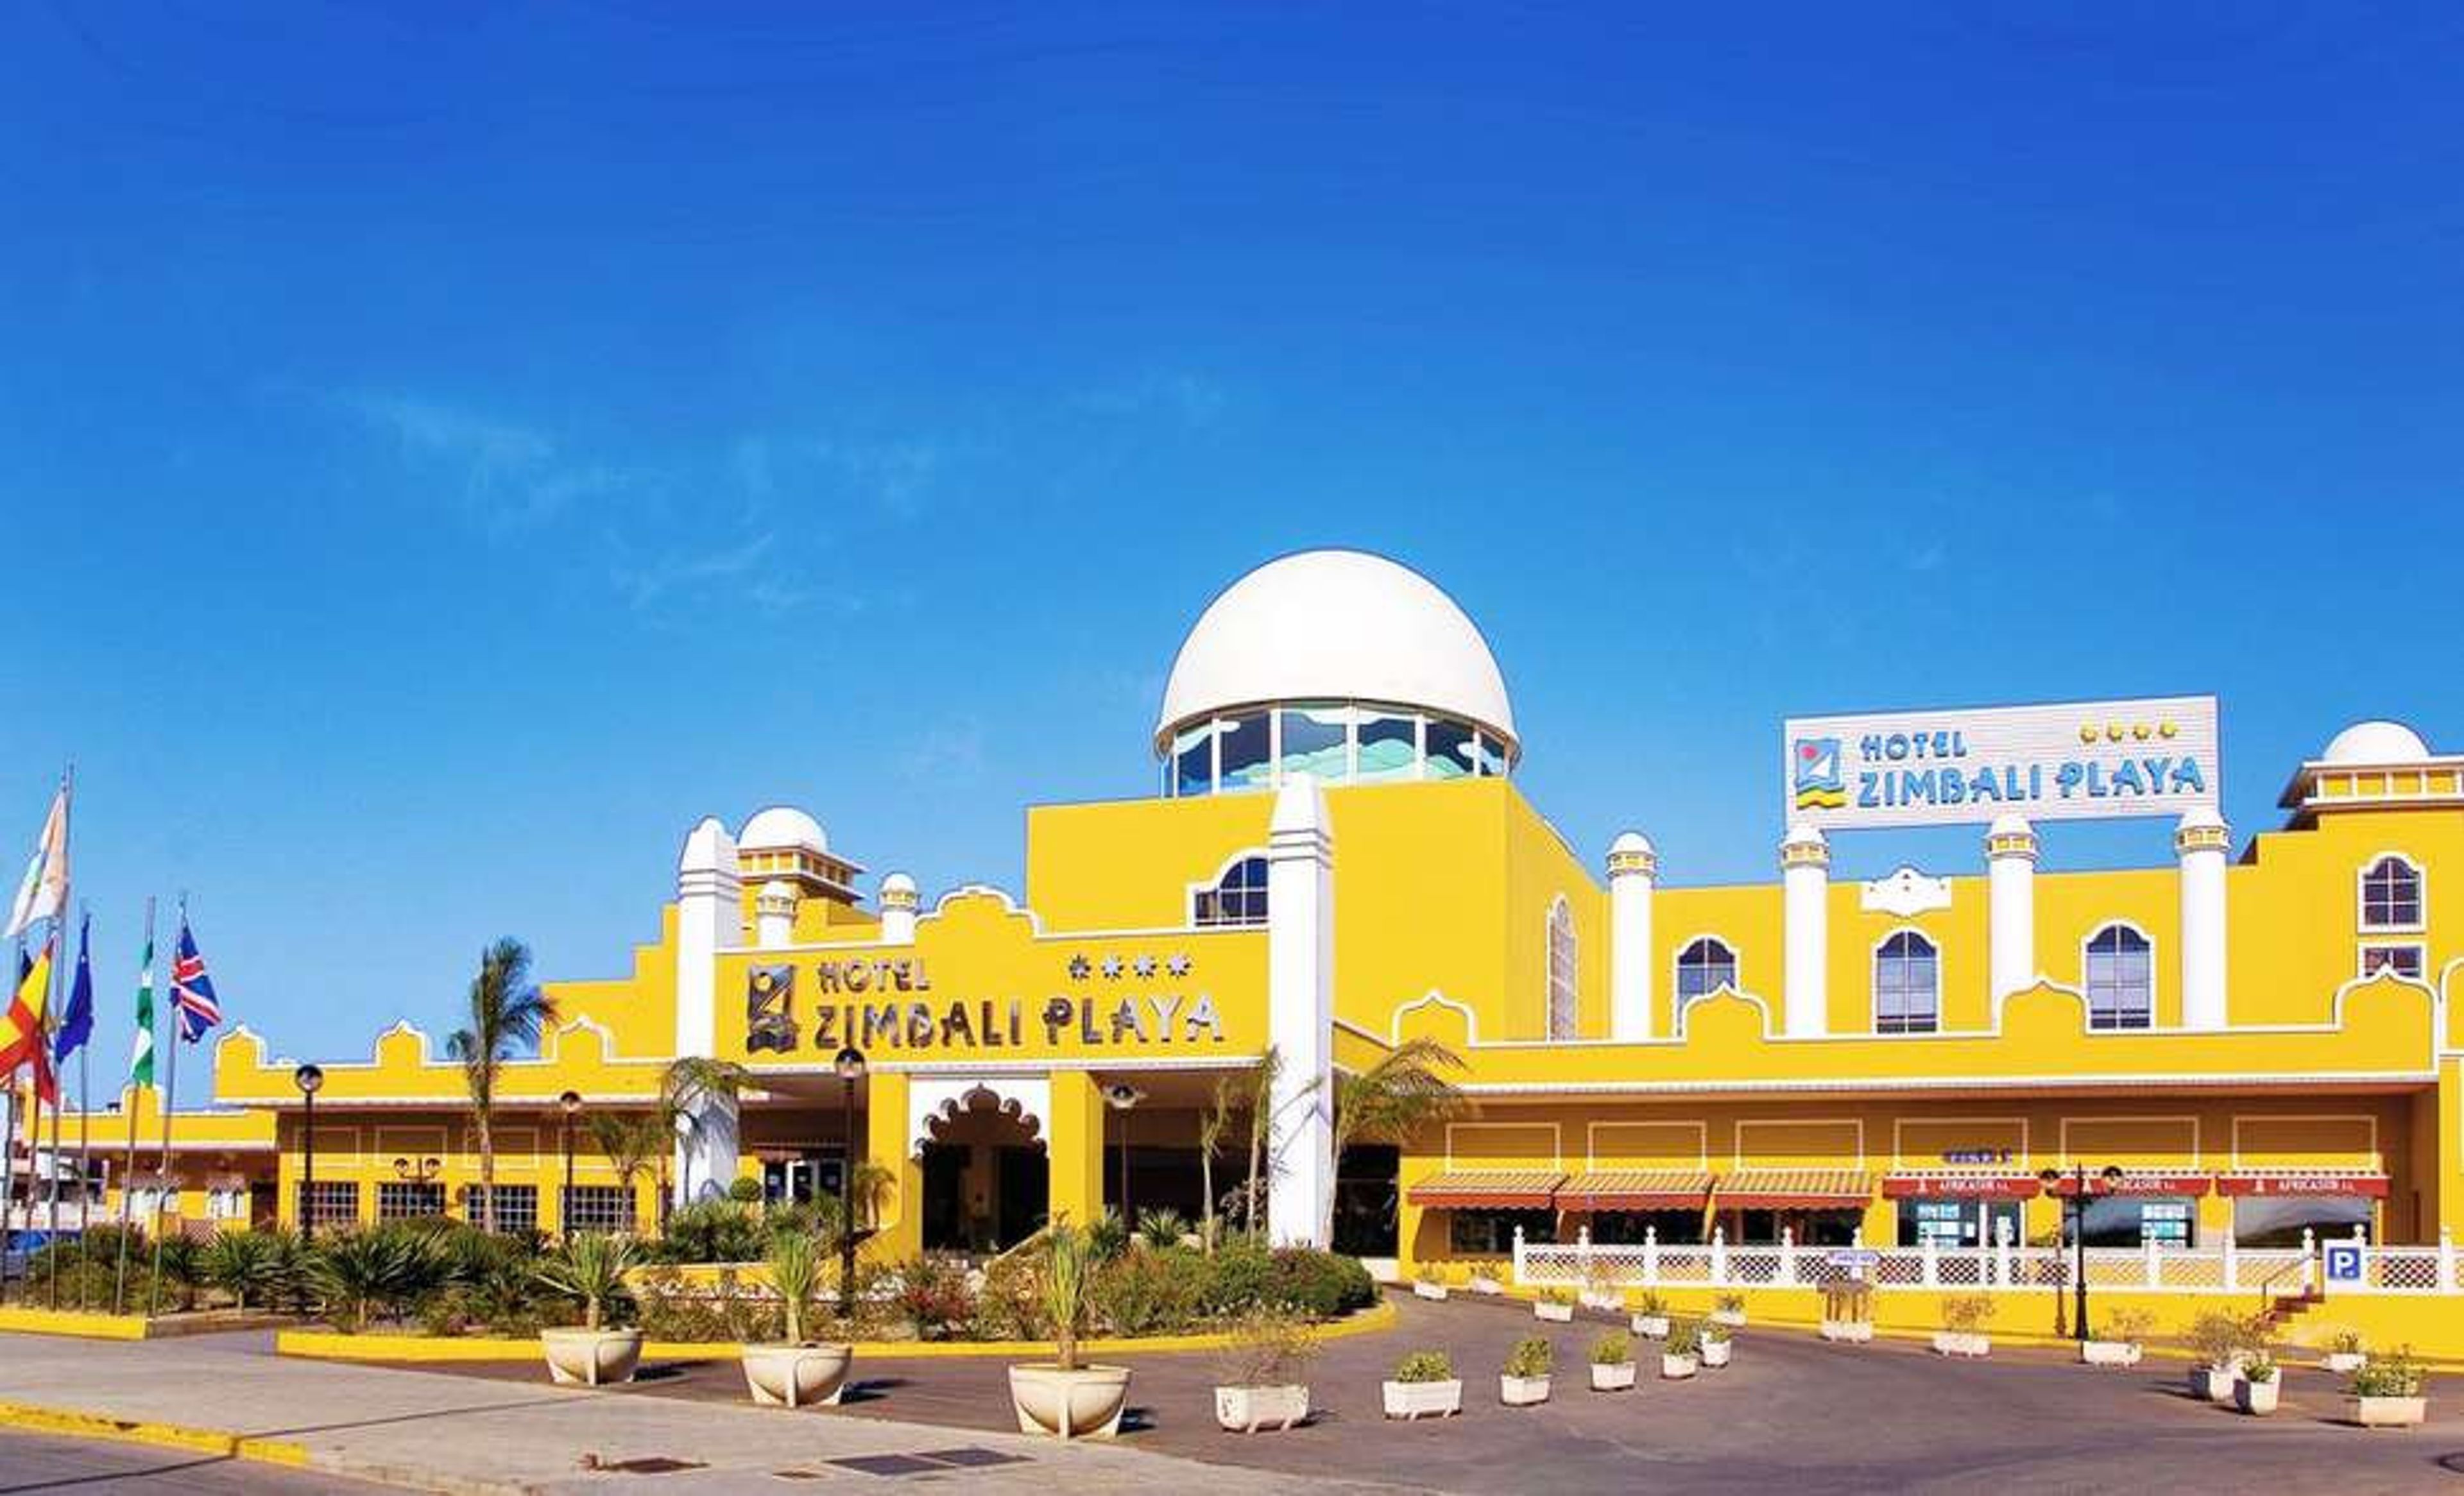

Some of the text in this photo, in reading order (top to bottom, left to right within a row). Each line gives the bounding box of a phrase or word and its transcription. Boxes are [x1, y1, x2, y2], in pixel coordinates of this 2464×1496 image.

[1860, 731, 1967, 761] HOTEL
[1858, 755, 2205, 808] ZIMBALI PLAYA
[817, 958, 930, 994] HOTEL
[815, 995, 1225, 1050] ZIMBALI PLAYA
[2334, 1251, 2354, 1275] P
